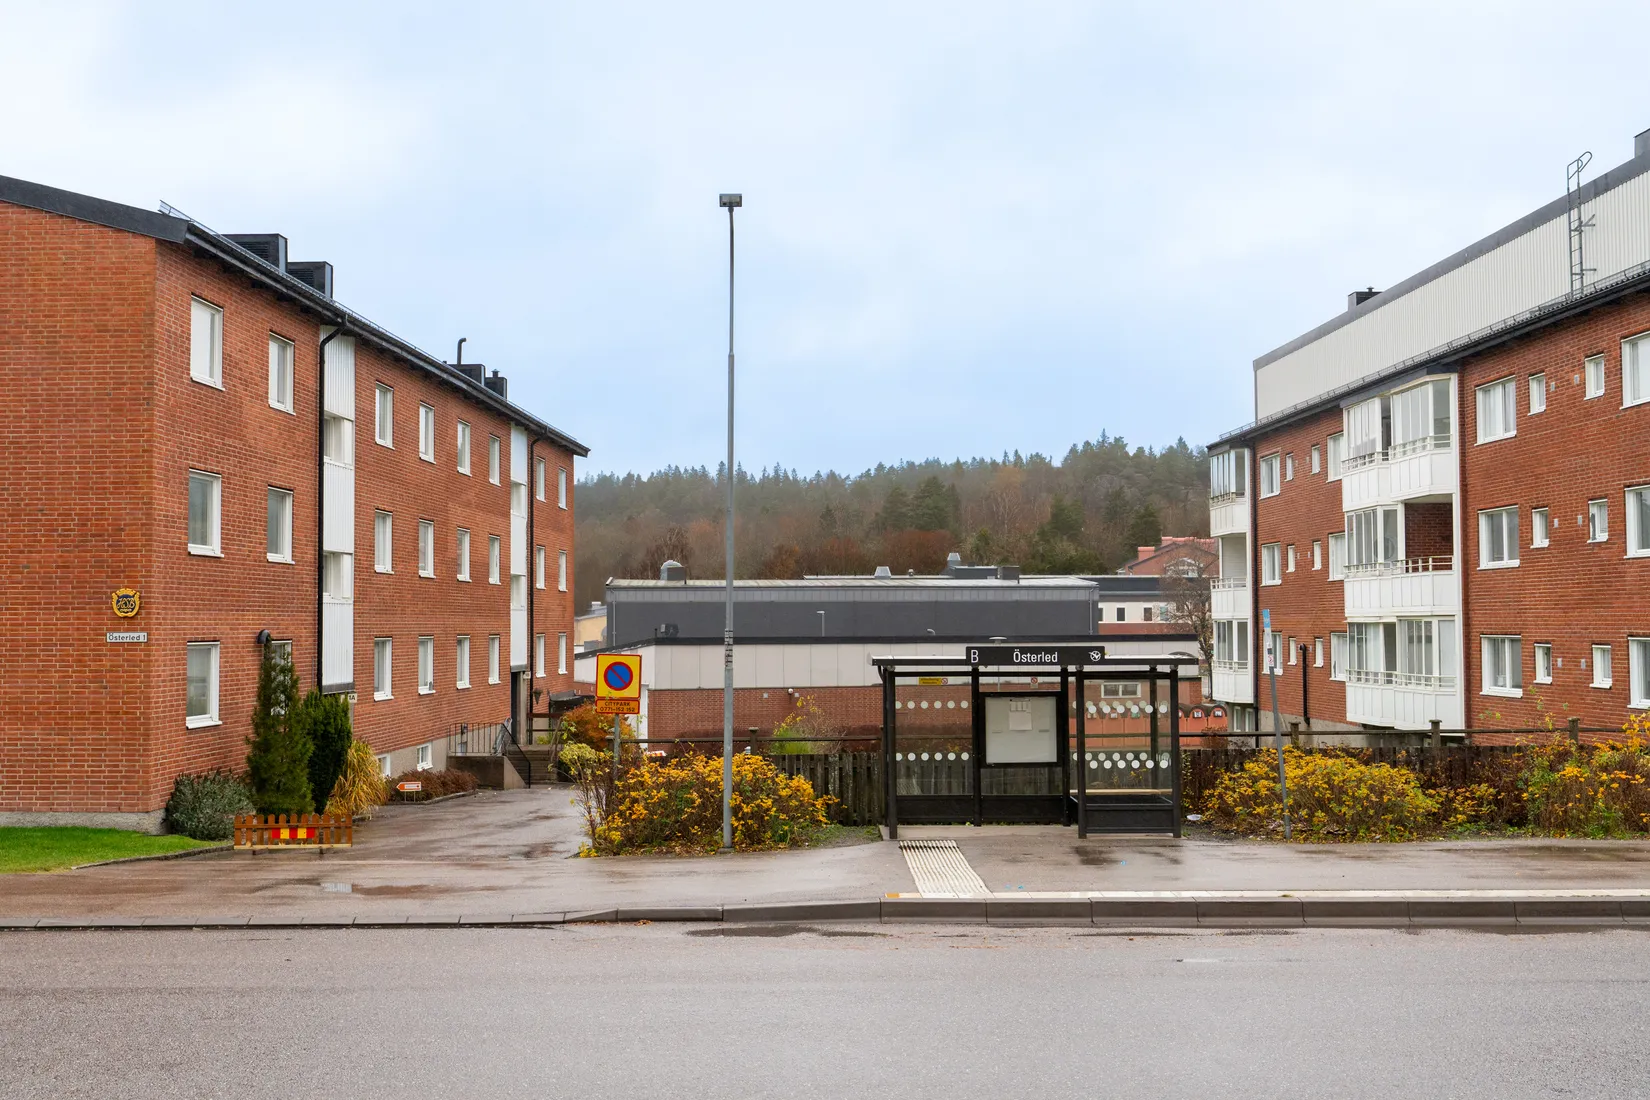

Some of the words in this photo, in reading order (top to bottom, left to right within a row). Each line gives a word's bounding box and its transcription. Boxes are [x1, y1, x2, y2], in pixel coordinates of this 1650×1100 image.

[109, 632, 140, 641] Österled
[970, 649, 979, 663] B
[1013, 649, 1058, 663] Österled
